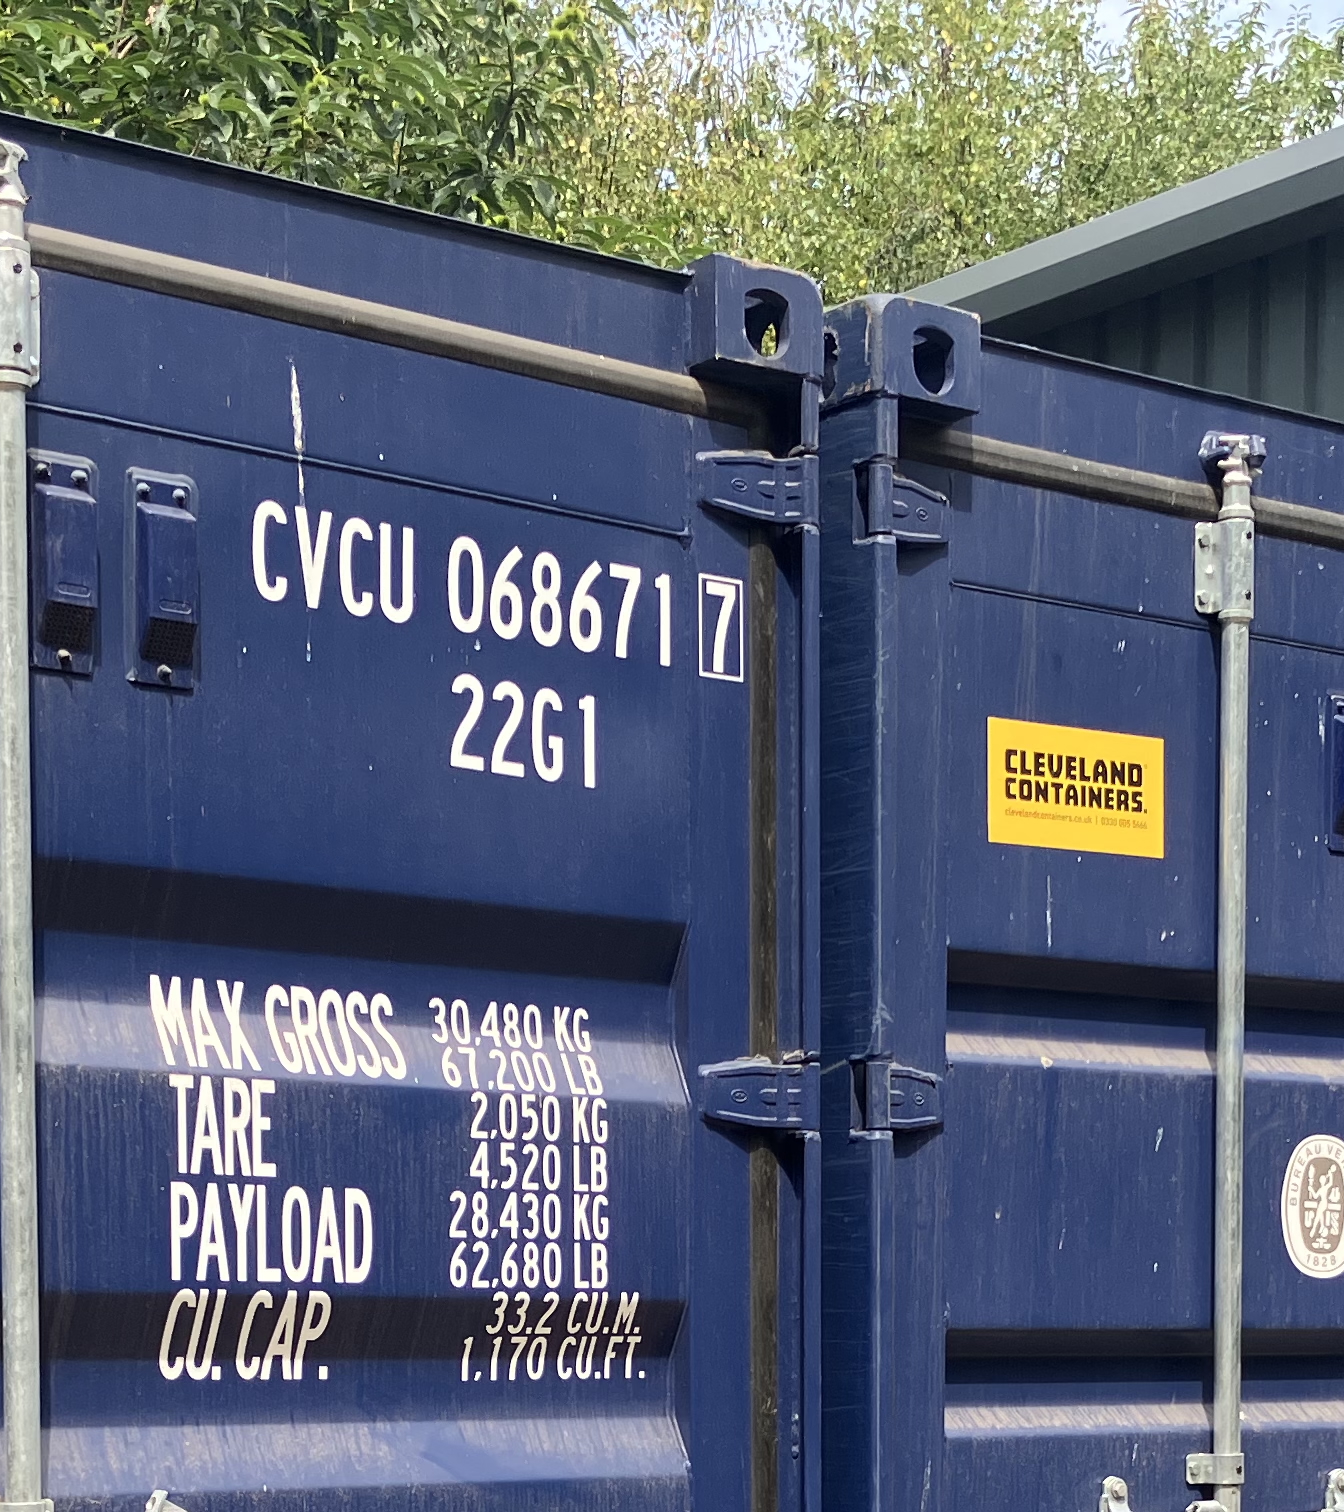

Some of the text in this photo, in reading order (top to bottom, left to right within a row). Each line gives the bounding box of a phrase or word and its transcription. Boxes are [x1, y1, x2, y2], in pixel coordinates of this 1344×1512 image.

[251, 499, 737, 674] CVCU 068671 7
[449, 672, 596, 789] 22G1
[1004, 748, 1143, 788] CLEVELAND
[1004, 777, 1148, 815] CONTAINERS.
[149, 974, 262, 1072] MAX
[264, 984, 407, 1081] GROSS
[553, 1005, 592, 1053] KG
[560, 1053, 604, 1096] LB
[169, 1073, 609, 1178] TARE 2,050 KG
[470, 1142, 609, 1193] 4,520 LB
[1289, 1143, 1322, 1207] BUREAU
[170, 1181, 609, 1284] PAYLOAD 28,430 KG
[1306, 1253, 1337, 1268] 1828
[449, 1241, 609, 1289] 62,680 LB
[159, 1289, 641, 1380] CU. CAP. 33.2 CU.M.
[461, 1336, 646, 1381] 1,170 CU.FT.
